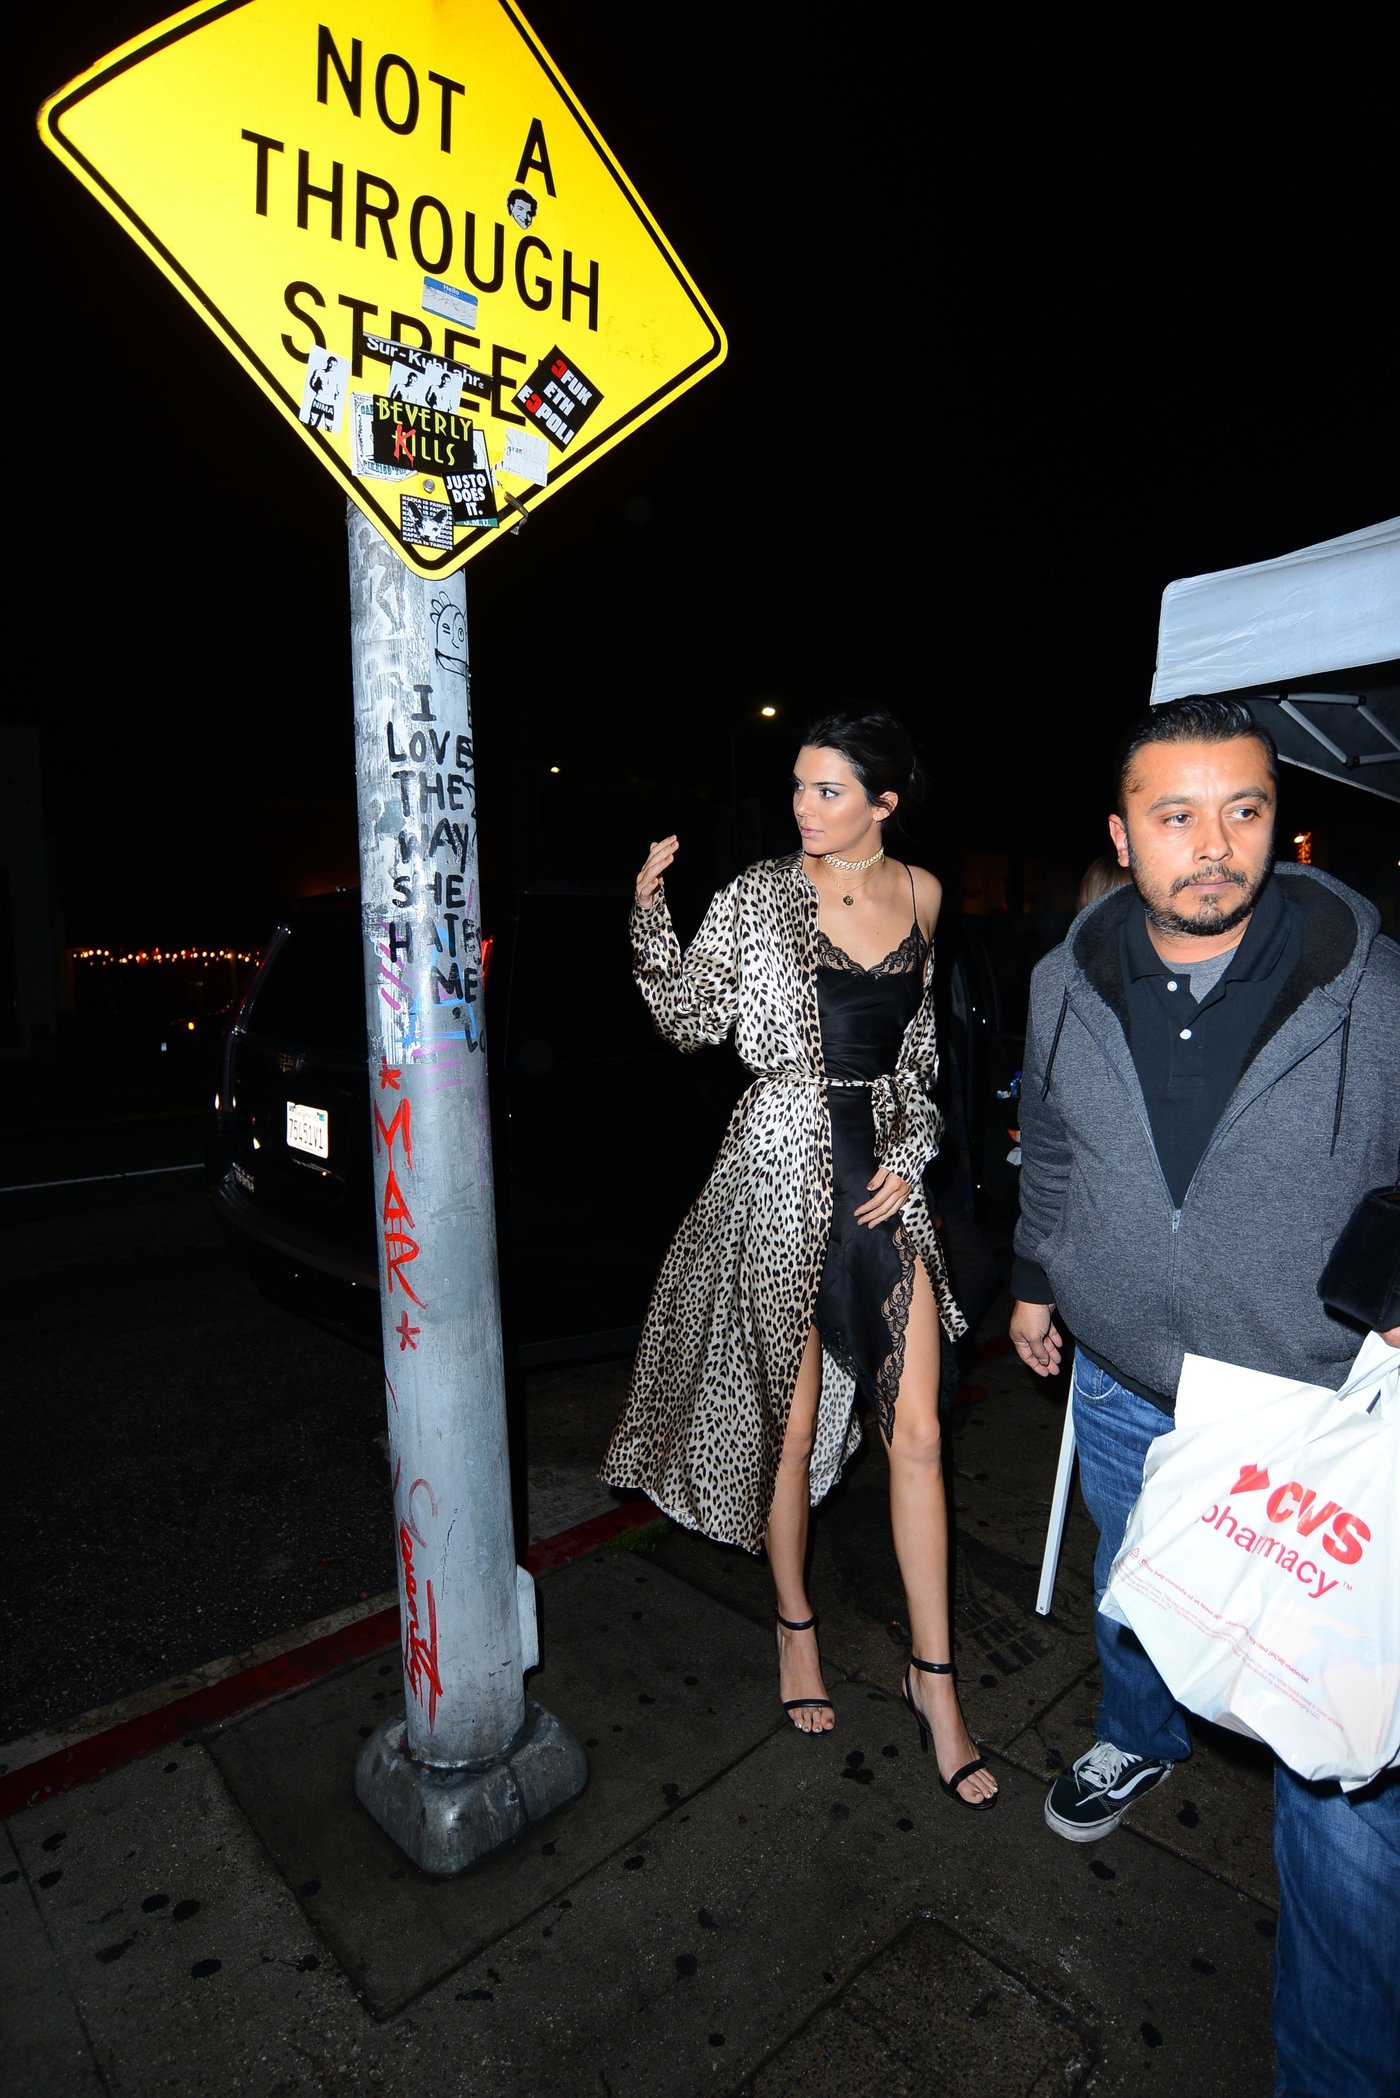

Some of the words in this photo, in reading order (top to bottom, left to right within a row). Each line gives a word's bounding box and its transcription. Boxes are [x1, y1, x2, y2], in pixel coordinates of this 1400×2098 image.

[316, 24, 465, 153] NOT
[515, 117, 557, 197] A
[241, 128, 599, 332] THROUGH
[313, 401, 334, 414] NIMA
[375, 397, 472, 441] BEVERLY
[543, 380, 575, 416] ETH
[393, 424, 455, 467] KILLS
[446, 474, 487, 490] JUSTO
[452, 487, 486, 503] DOES
[465, 502, 483, 516] IT.
[411, 684, 437, 721] I
[387, 721, 474, 771] LOVE
[392, 770, 464, 817] THE
[392, 871, 466, 909] SHE
[431, 963, 477, 1004] ME
[1266, 1481, 1371, 1565] CVS
[1197, 1504, 1339, 1599] pharmacy
